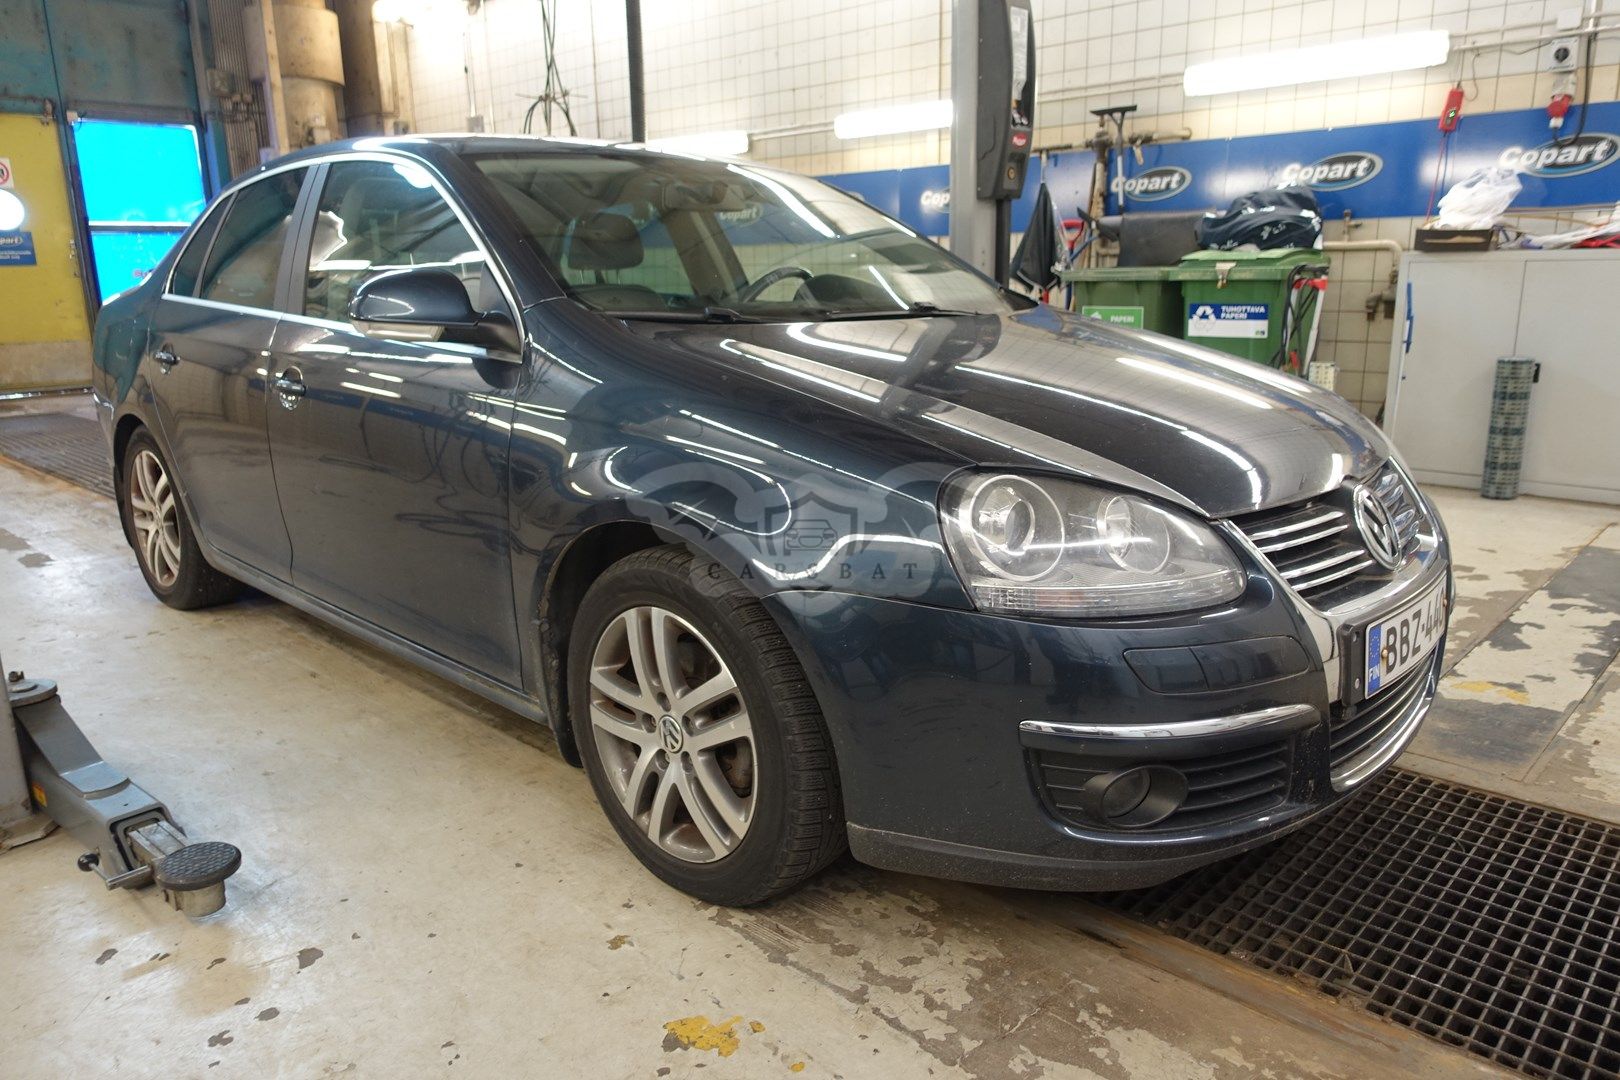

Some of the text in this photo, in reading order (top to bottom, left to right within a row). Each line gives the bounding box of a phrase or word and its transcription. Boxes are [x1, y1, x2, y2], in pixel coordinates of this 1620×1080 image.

[1498, 139, 1612, 169] Copart
[1281, 159, 1371, 184] Copart
[1111, 172, 1181, 195] Copart
[920, 190, 951, 207] Cop
[1110, 315, 1135, 323] PAPERI
[1368, 663, 1381, 683] FIN
